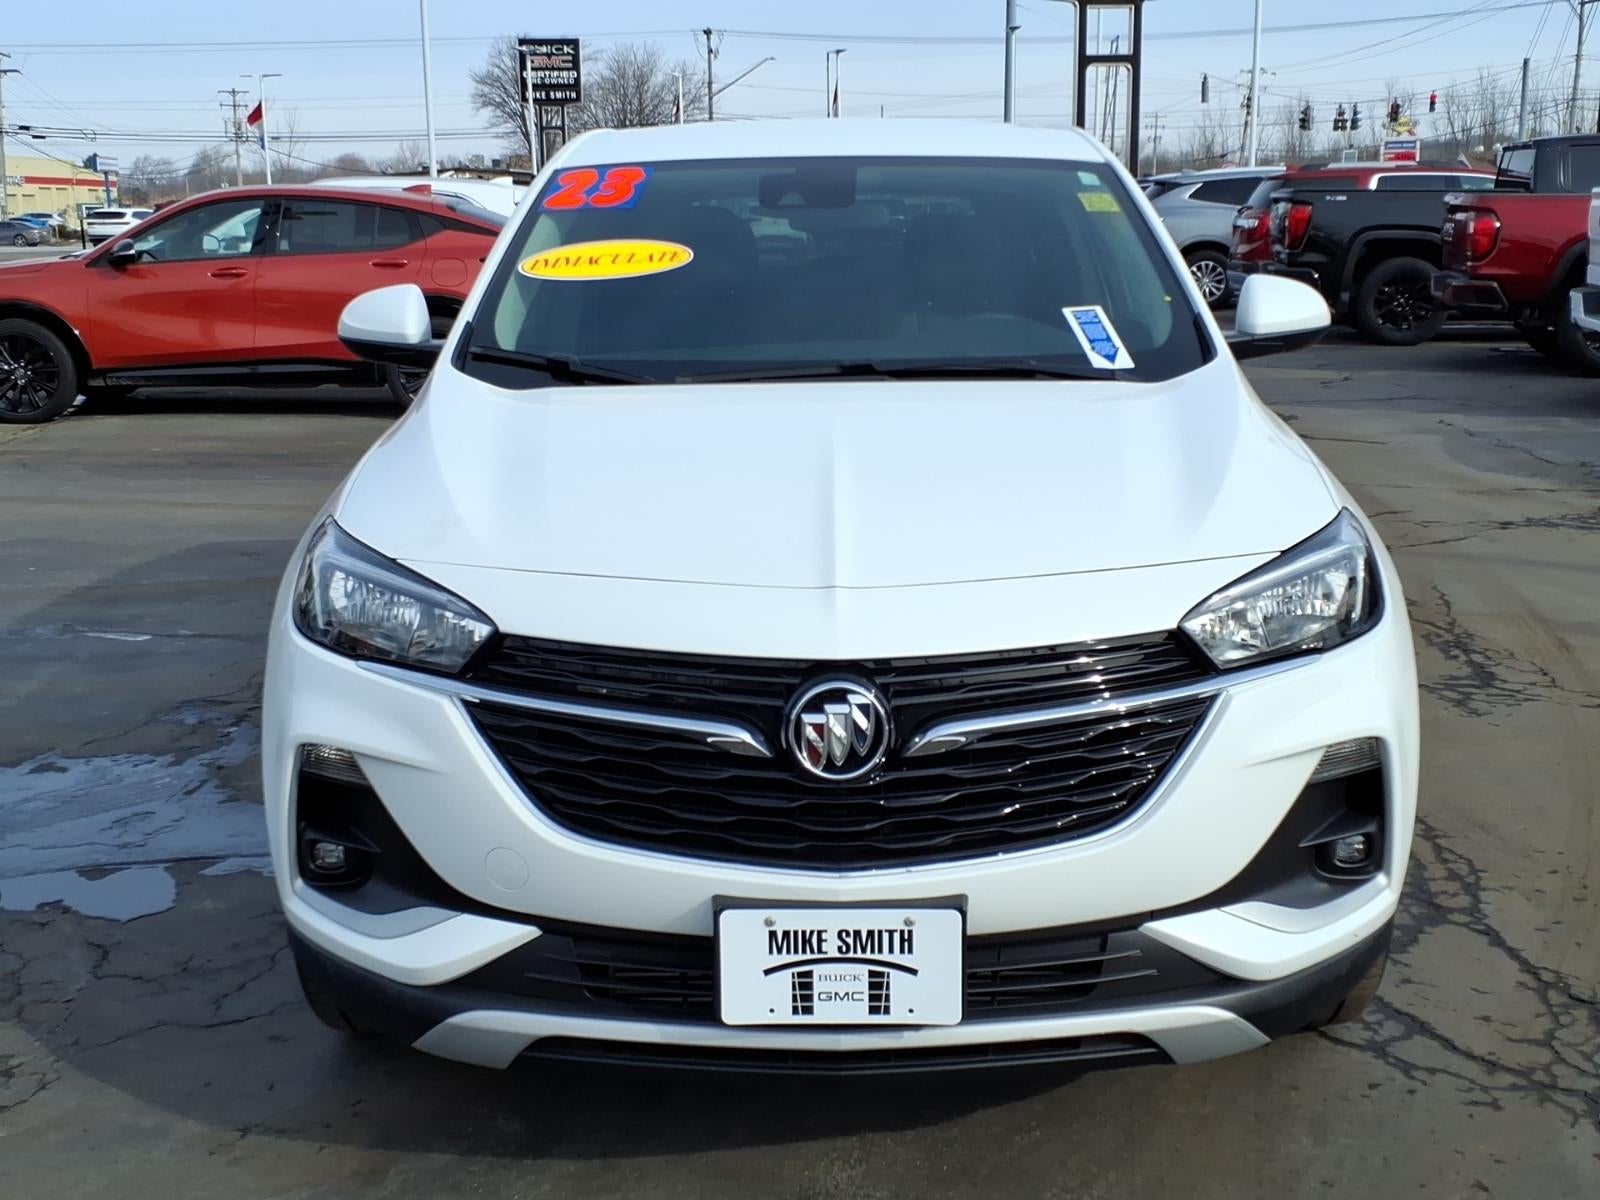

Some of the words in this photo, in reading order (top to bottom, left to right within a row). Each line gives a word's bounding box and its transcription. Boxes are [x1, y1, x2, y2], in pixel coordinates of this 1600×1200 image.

[550, 91, 577, 99] SMITH
[543, 166, 646, 210] 23
[530, 250, 684, 271] IMMACULATE
[768, 929, 828, 955] MIKE
[837, 929, 914, 955] SMITH
[818, 973, 864, 982] BUICK
[817, 991, 865, 1002] GMC
